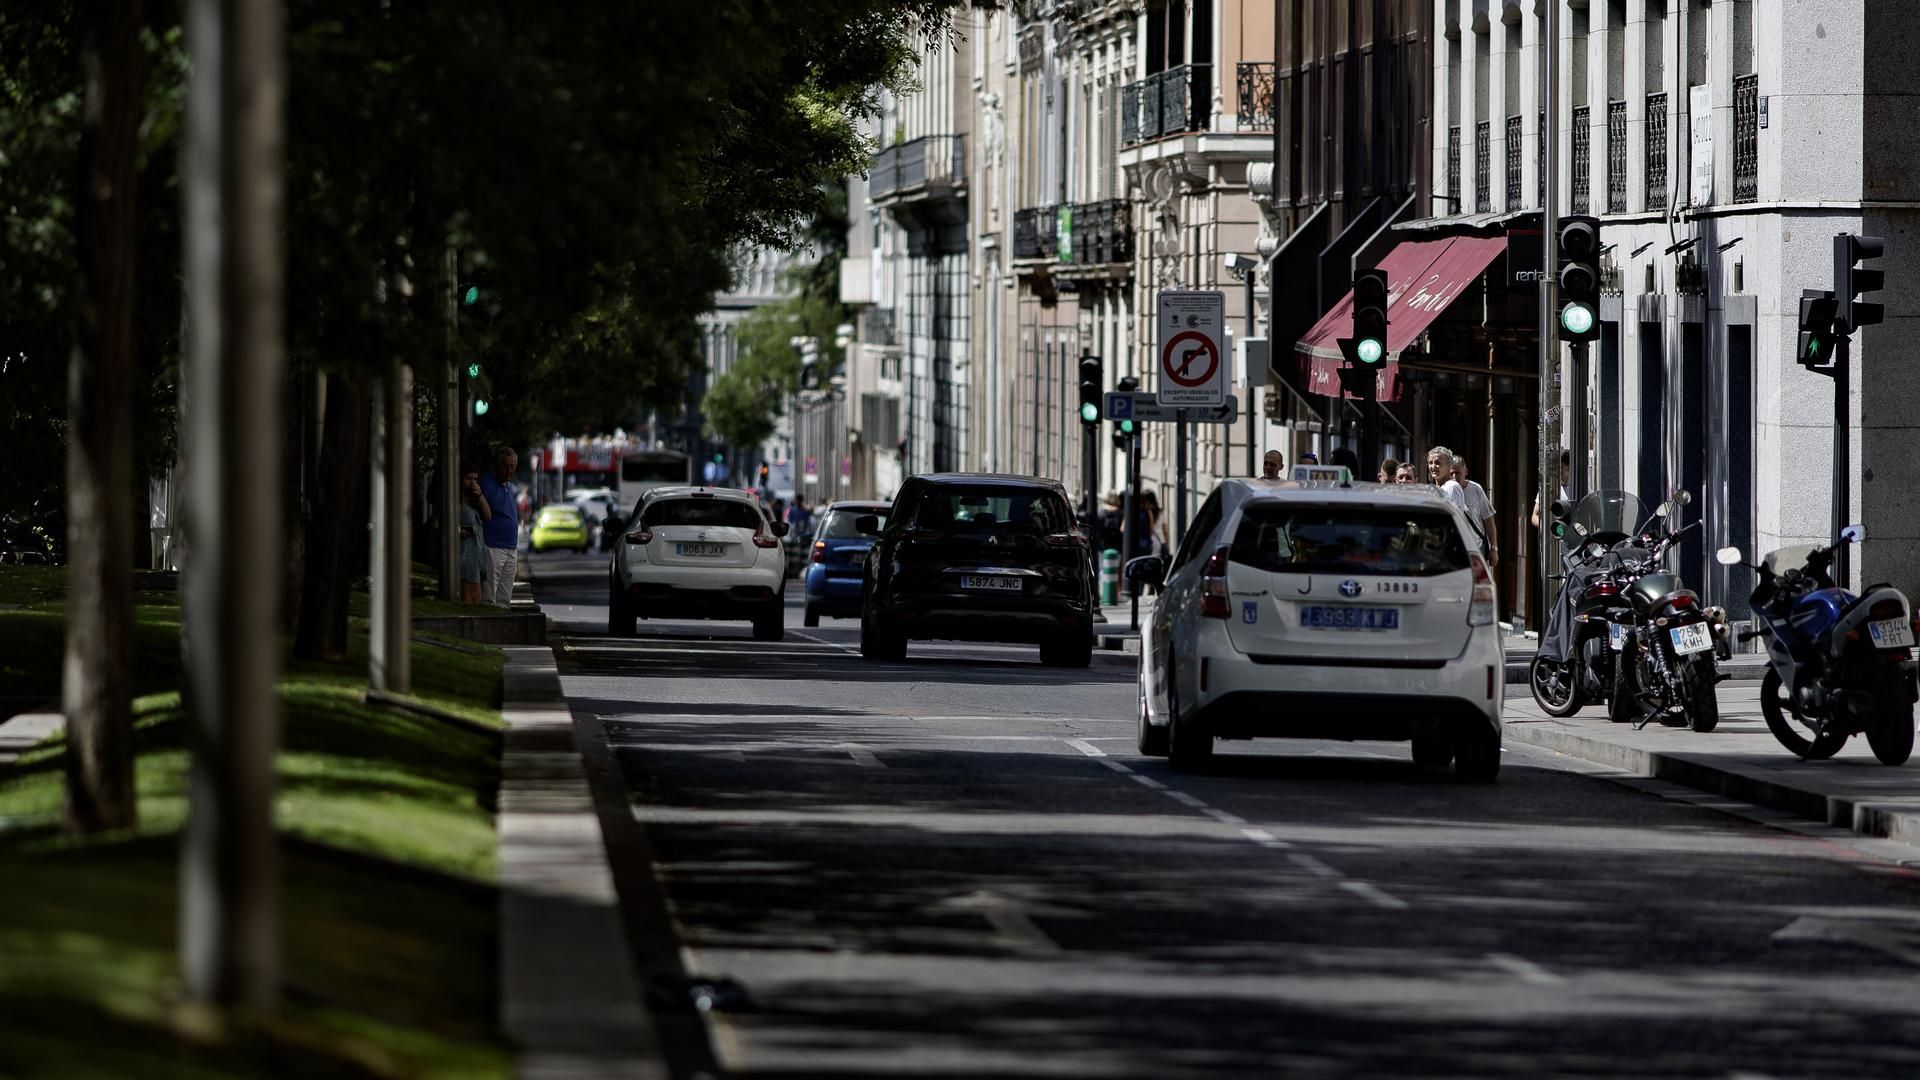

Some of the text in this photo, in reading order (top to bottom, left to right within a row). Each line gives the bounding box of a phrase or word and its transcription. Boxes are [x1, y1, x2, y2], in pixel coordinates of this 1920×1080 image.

[1114, 398, 1127, 415] P
[1311, 471, 1339, 481] TAXI
[683, 544, 706, 554] 9063
[968, 578, 1020, 588] 5874 JNC
[1297, 575, 1419, 595] J 13893
[1312, 609, 1398, 627] 3993 KWJ
[1879, 620, 1908, 633] 3344
[1683, 637, 1704, 650] KMH
[1882, 632, 1903, 646] FRT
